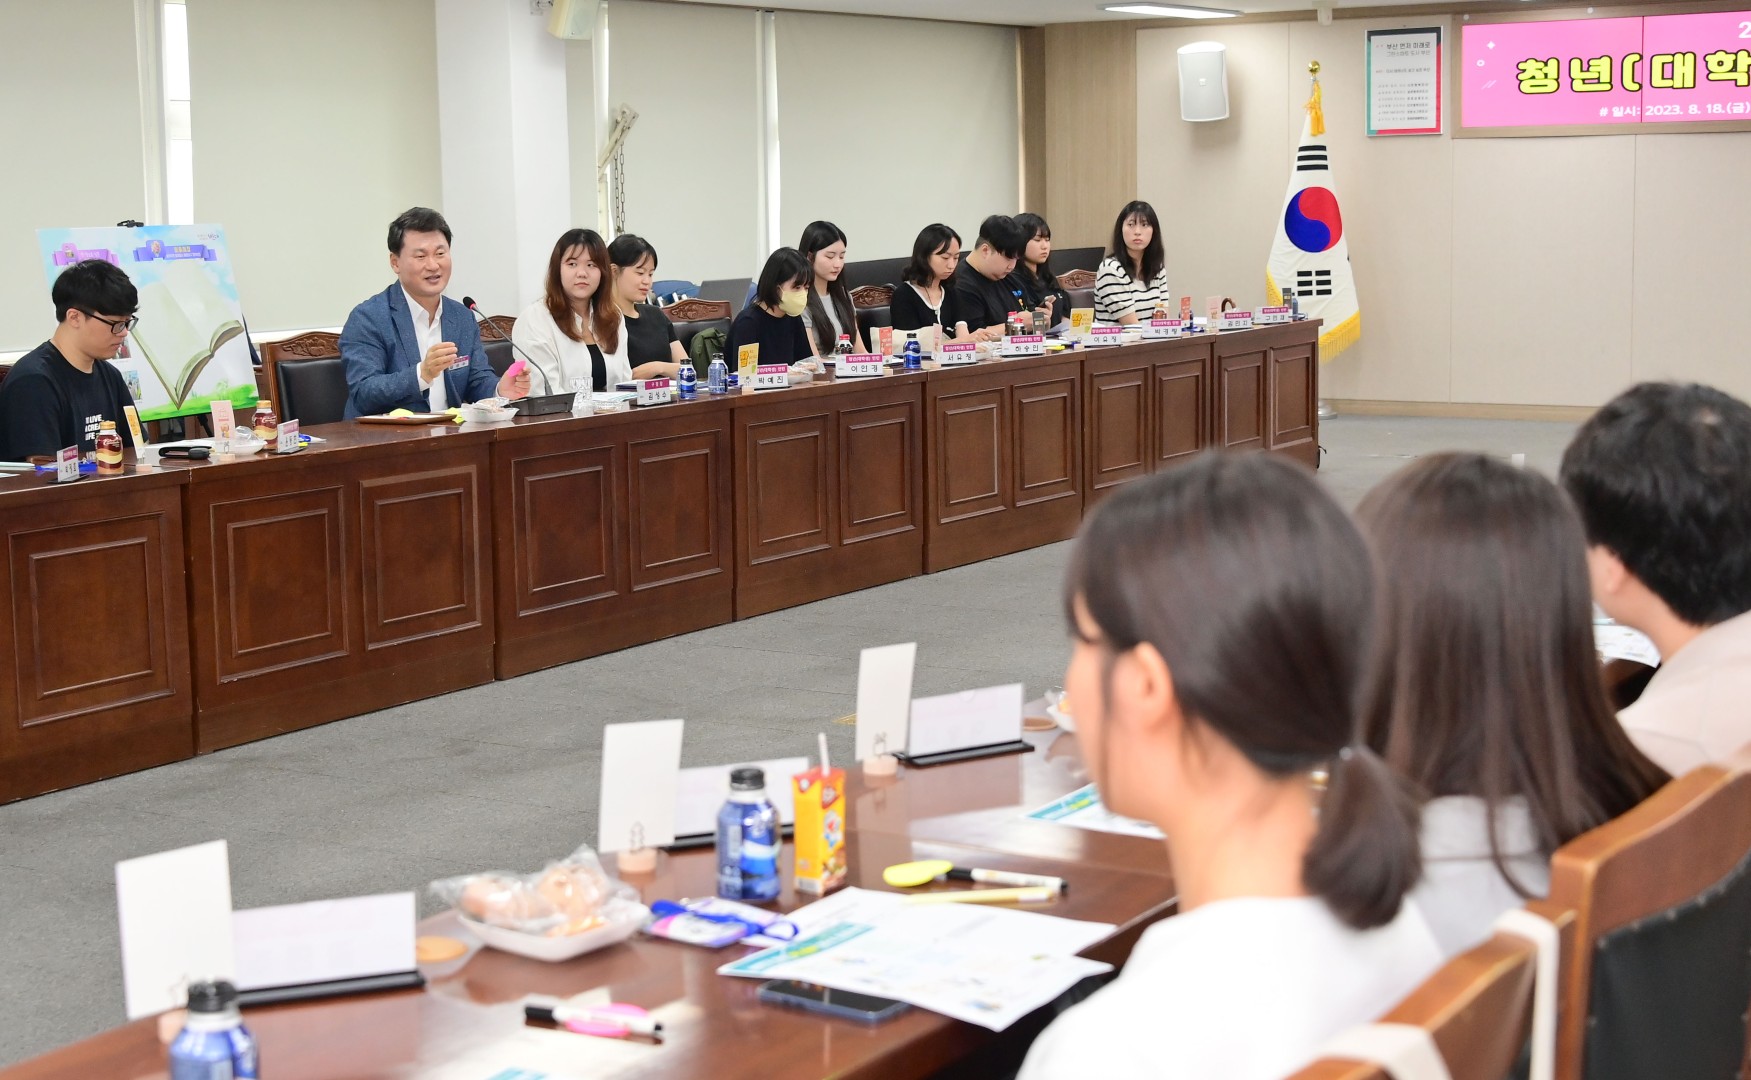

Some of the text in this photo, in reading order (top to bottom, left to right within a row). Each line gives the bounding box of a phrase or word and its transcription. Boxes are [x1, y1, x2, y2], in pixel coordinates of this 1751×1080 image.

[1612, 104, 1641, 118] 일시:
[1645, 105, 1684, 116] 2023.
[1688, 103, 1701, 115] 8.
